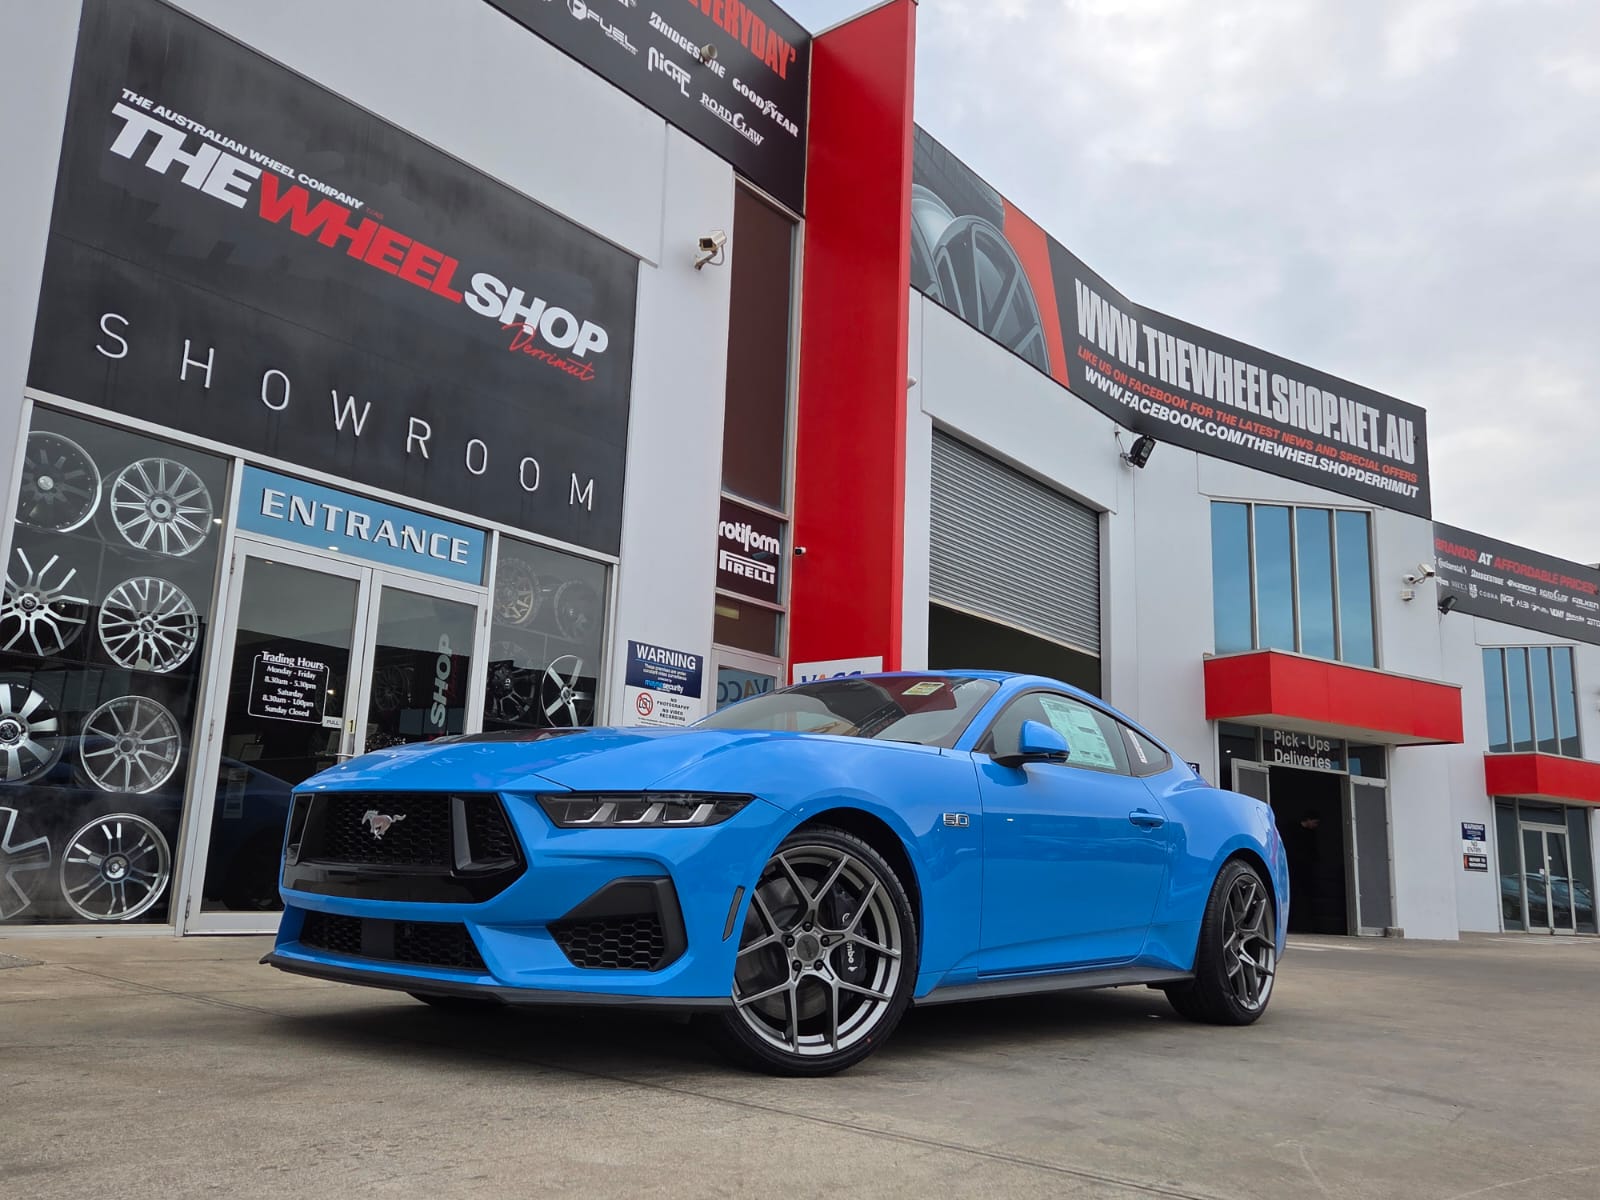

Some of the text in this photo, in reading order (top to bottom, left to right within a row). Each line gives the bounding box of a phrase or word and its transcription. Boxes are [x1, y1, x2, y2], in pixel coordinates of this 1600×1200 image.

[587, 9, 638, 52] FUEL
[648, 11, 726, 78] BRIDGESONE
[732, 78, 799, 137] GOODYEAR
[122, 88, 153, 110] THE
[153, 105, 248, 155] AUSTRALIAN
[250, 149, 296, 179] WHEEL
[298, 174, 364, 209] COMPANY
[110, 102, 608, 358] THE WHEEL SHOP
[502, 322, 595, 381] Derrimut
[96, 313, 594, 512] SHOWROOM
[1078, 345, 1418, 483] LIKE US ON FACEBOOK FOR THE LATEST NEWS AND SPECIAL OFFERS
[1085, 365, 1419, 498] WWW.FACEBOOK.COM/THEWHEELSHOPDERRIMUT
[260, 488, 470, 565] ENTRANCE
[718, 521, 780, 555] rotiform
[719, 550, 776, 584] PIRELLI
[1478, 552, 1493, 566] AT
[1494, 556, 1558, 585] AFFORDABLE
[262, 651, 324, 670] Trading Hours
[266, 665, 293, 676] Monday
[298, 670, 316, 680] Friday
[636, 644, 696, 670] WARNING
[277, 688, 303, 699] Saturday
[431, 633, 452, 728] SHOP
[265, 705, 309, 717] Sunday Closed
[1274, 730, 1299, 748] Pick
[1308, 736, 1330, 754] Ups
[1274, 748, 1332, 770] Deliveries
